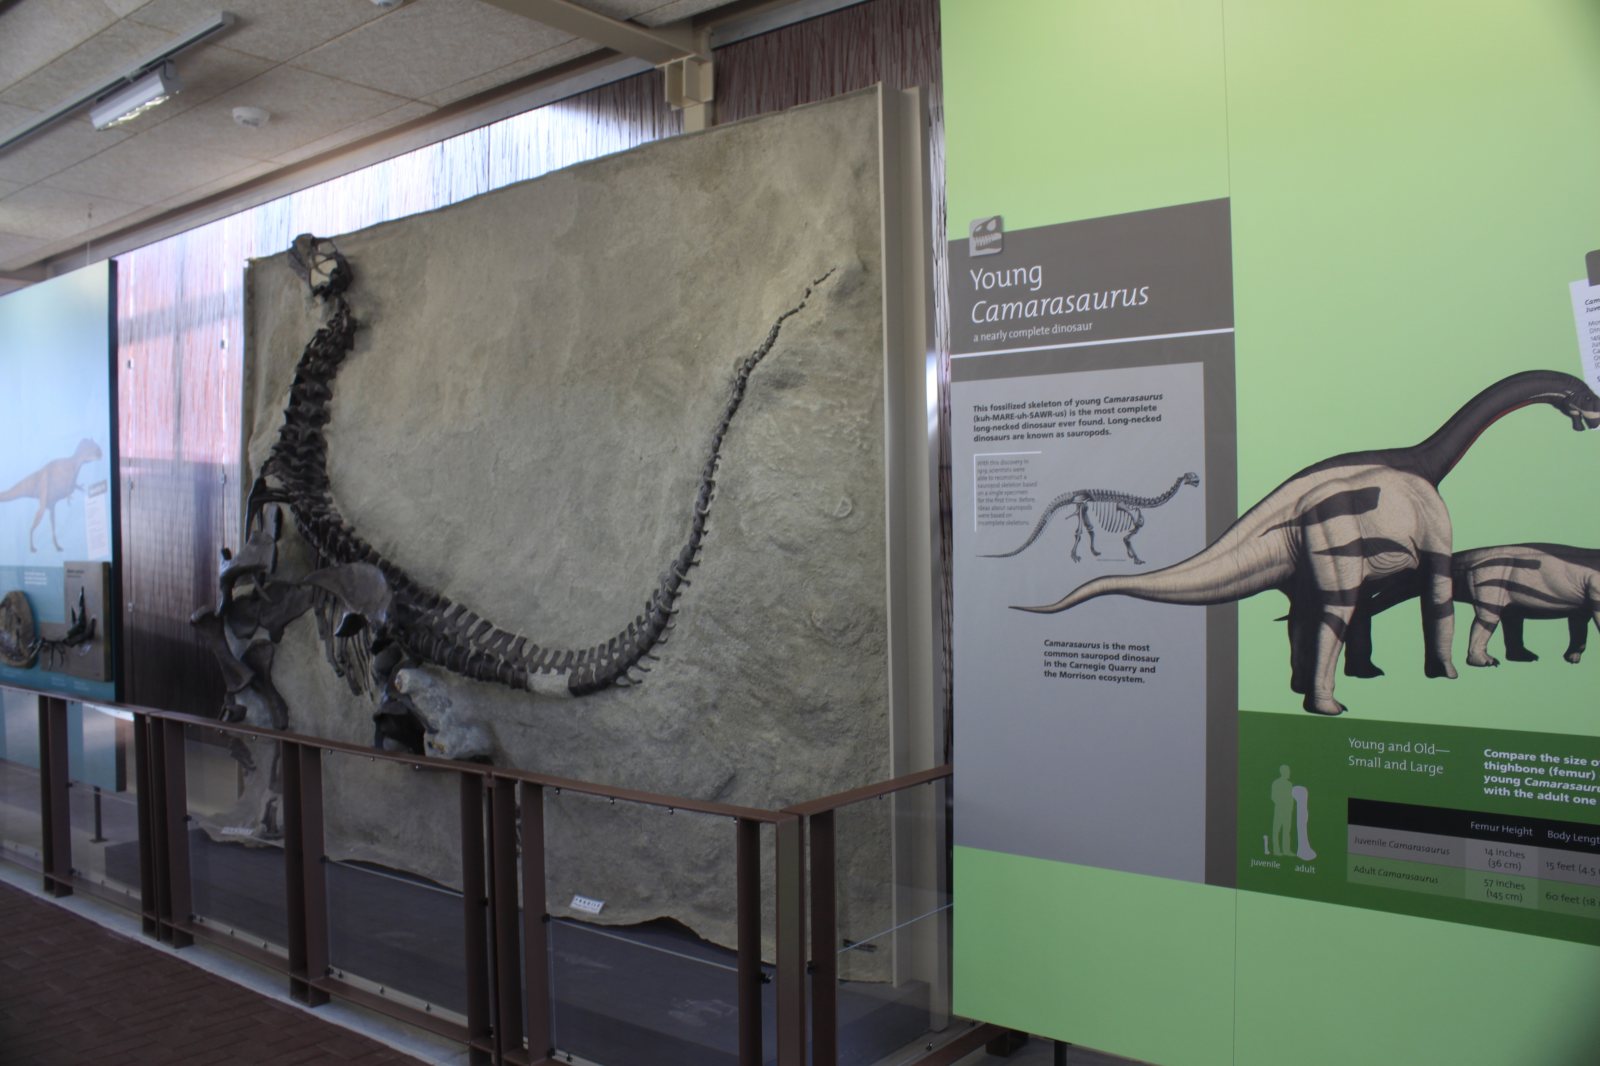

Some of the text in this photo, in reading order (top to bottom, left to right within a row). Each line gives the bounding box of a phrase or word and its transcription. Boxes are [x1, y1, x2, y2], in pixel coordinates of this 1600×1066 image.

[970, 265, 1042, 291] Young
[971, 286, 1149, 324] Camarasaurus
[973, 322, 1093, 342] a nearly complete dinosaur
[990, 402, 1026, 411] fossilized
[1028, 401, 1062, 409] skeleton
[1064, 398, 1073, 406] of
[1075, 398, 1101, 407] young
[1103, 393, 1163, 403] Camarasaurus
[973, 409, 1067, 423] (kuh-MARE-uh-SAWR-us)
[1094, 407, 1115, 415] most
[1117, 405, 1157, 414] complete
[973, 421, 1020, 433] long-necked
[1021, 421, 1056, 430] dinosaur
[1078, 417, 1105, 426] found.
[1107, 414, 1162, 426] Long-necked
[973, 433, 1010, 442] dinosaurs
[1066, 428, 1112, 438] sauropods.
[1044, 639, 1150, 652] Camarasaurus is the most
[1043, 650, 1160, 663] common sauropod dinosaur
[1054, 660, 1067, 668] the
[1069, 661, 1106, 672] Carnegie
[1108, 663, 1137, 674] Quarry
[1139, 666, 1156, 674] and
[1043, 670, 1146, 684] the Morrison ecosystem.
[1348, 737, 1385, 754] Young
[1388, 741, 1411, 753] and
[1483, 748, 1600, 767] Compare the size o
[1348, 755, 1444, 777] Small and Large
[1483, 761, 1596, 781] thighbone (femur)
[1483, 775, 1521, 787] young
[1483, 786, 1597, 806] with the adult one
[1470, 821, 1533, 837] Femur Height
[1547, 830, 1571, 843] Body
[1388, 841, 1451, 855] Camarasaurus
[1484, 847, 1526, 859] 14 inches
[1250, 858, 1316, 875] juvenile adult
[1488, 858, 1522, 872] (36 cm)
[1546, 861, 1596, 877] 15 feet (4.5
[1353, 865, 1439, 884] Adult Camarasaurus
[1483, 879, 1526, 891] 57 inches
[1486, 889, 1523, 903] (145 cm)
[1545, 891, 1596, 908] 60 feet (18
